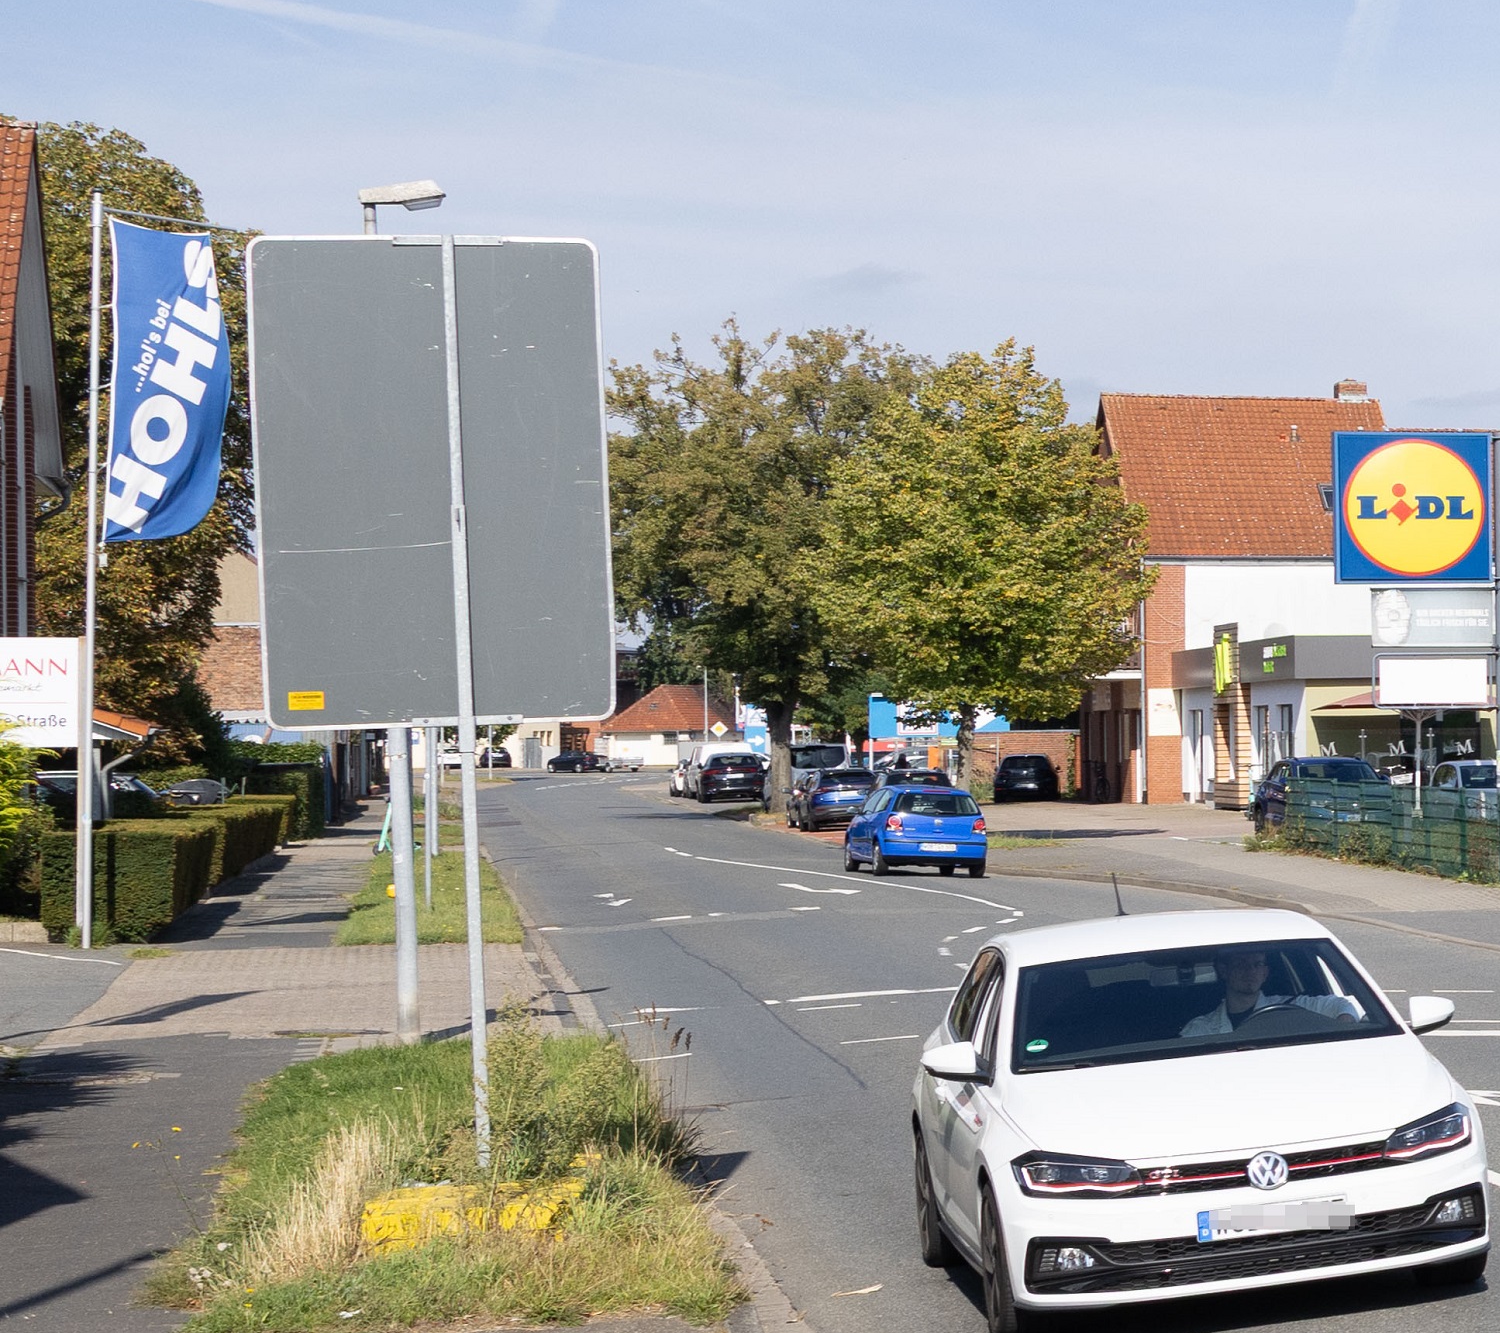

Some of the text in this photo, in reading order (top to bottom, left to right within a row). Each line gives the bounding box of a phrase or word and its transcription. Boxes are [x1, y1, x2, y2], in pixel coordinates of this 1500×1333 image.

[150, 297, 172, 327] bei
[105, 239, 221, 534] HOHLS
[0, 658, 67, 676] ANN
[17, 714, 67, 728] Straße
